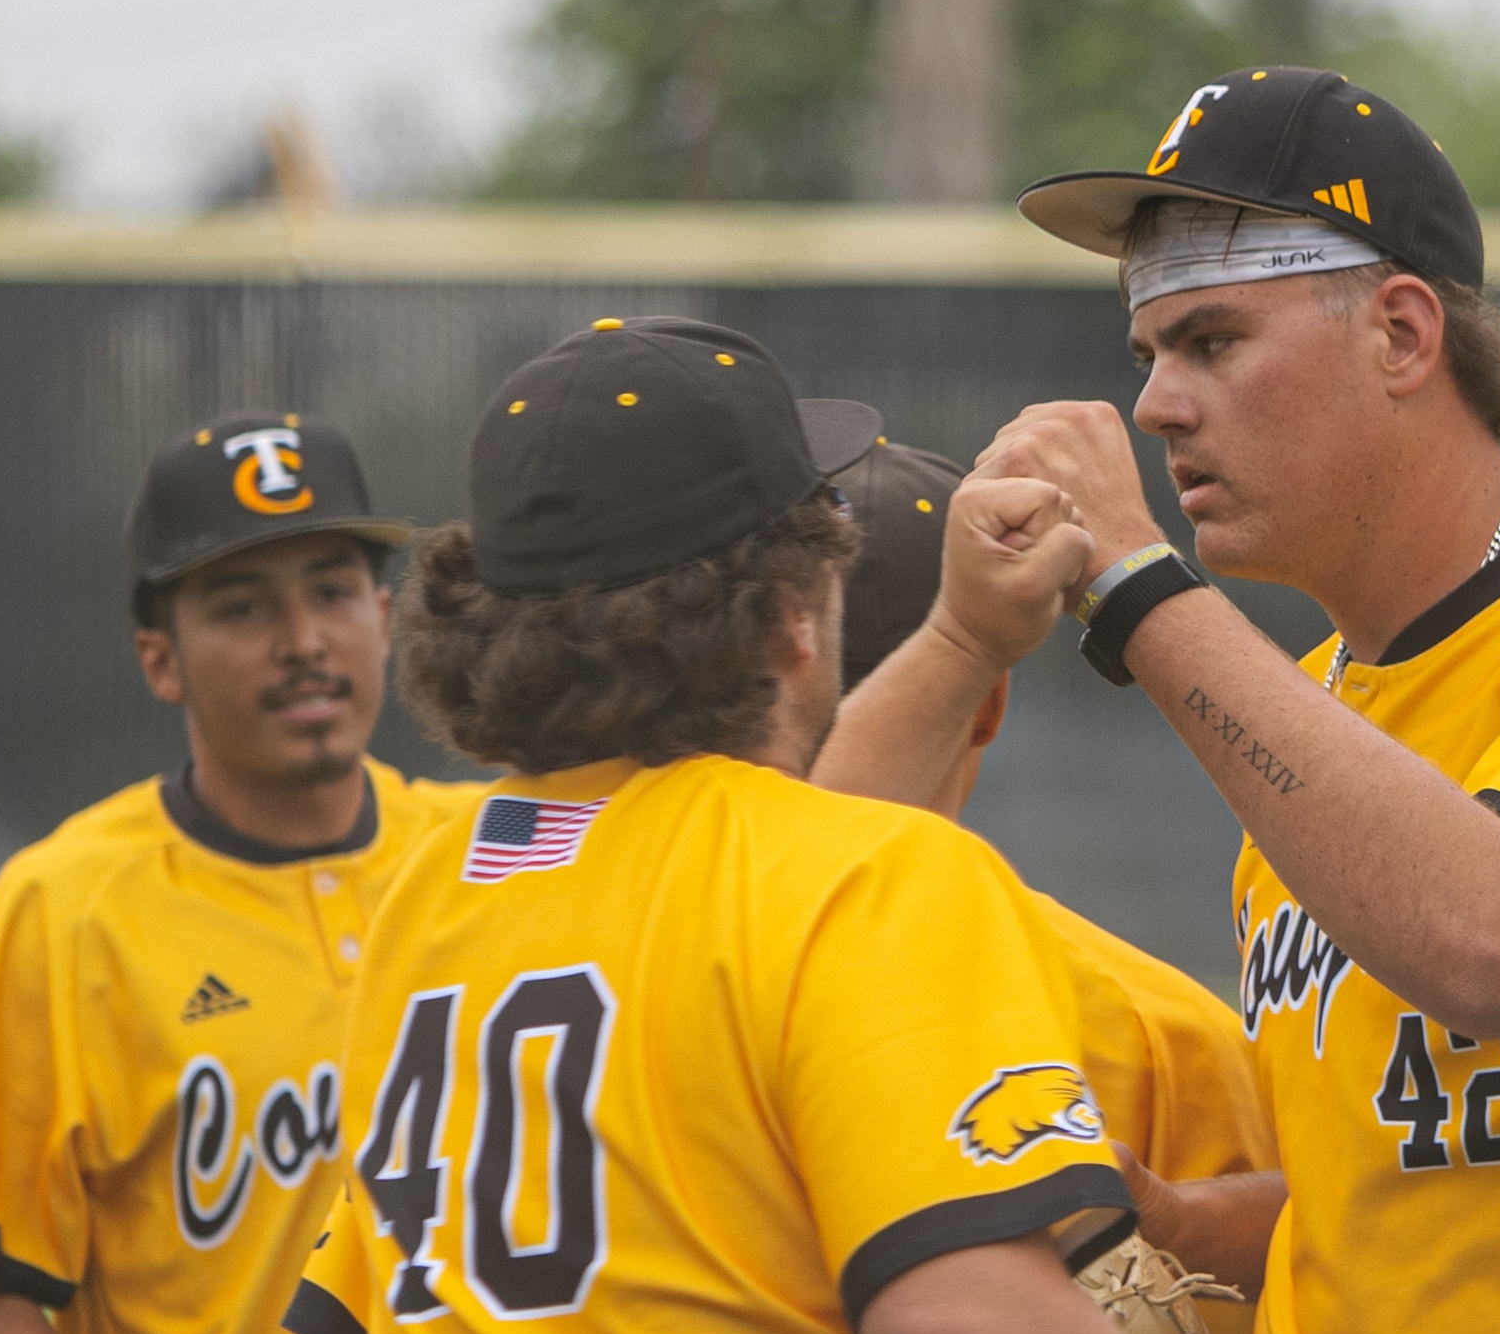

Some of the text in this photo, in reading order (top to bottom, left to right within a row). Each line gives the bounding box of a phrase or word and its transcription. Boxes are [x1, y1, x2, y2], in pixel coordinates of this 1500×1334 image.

[1261, 247, 1326, 269] JUNK
[223, 428, 314, 515] TC
[354, 962, 620, 1324] 40
